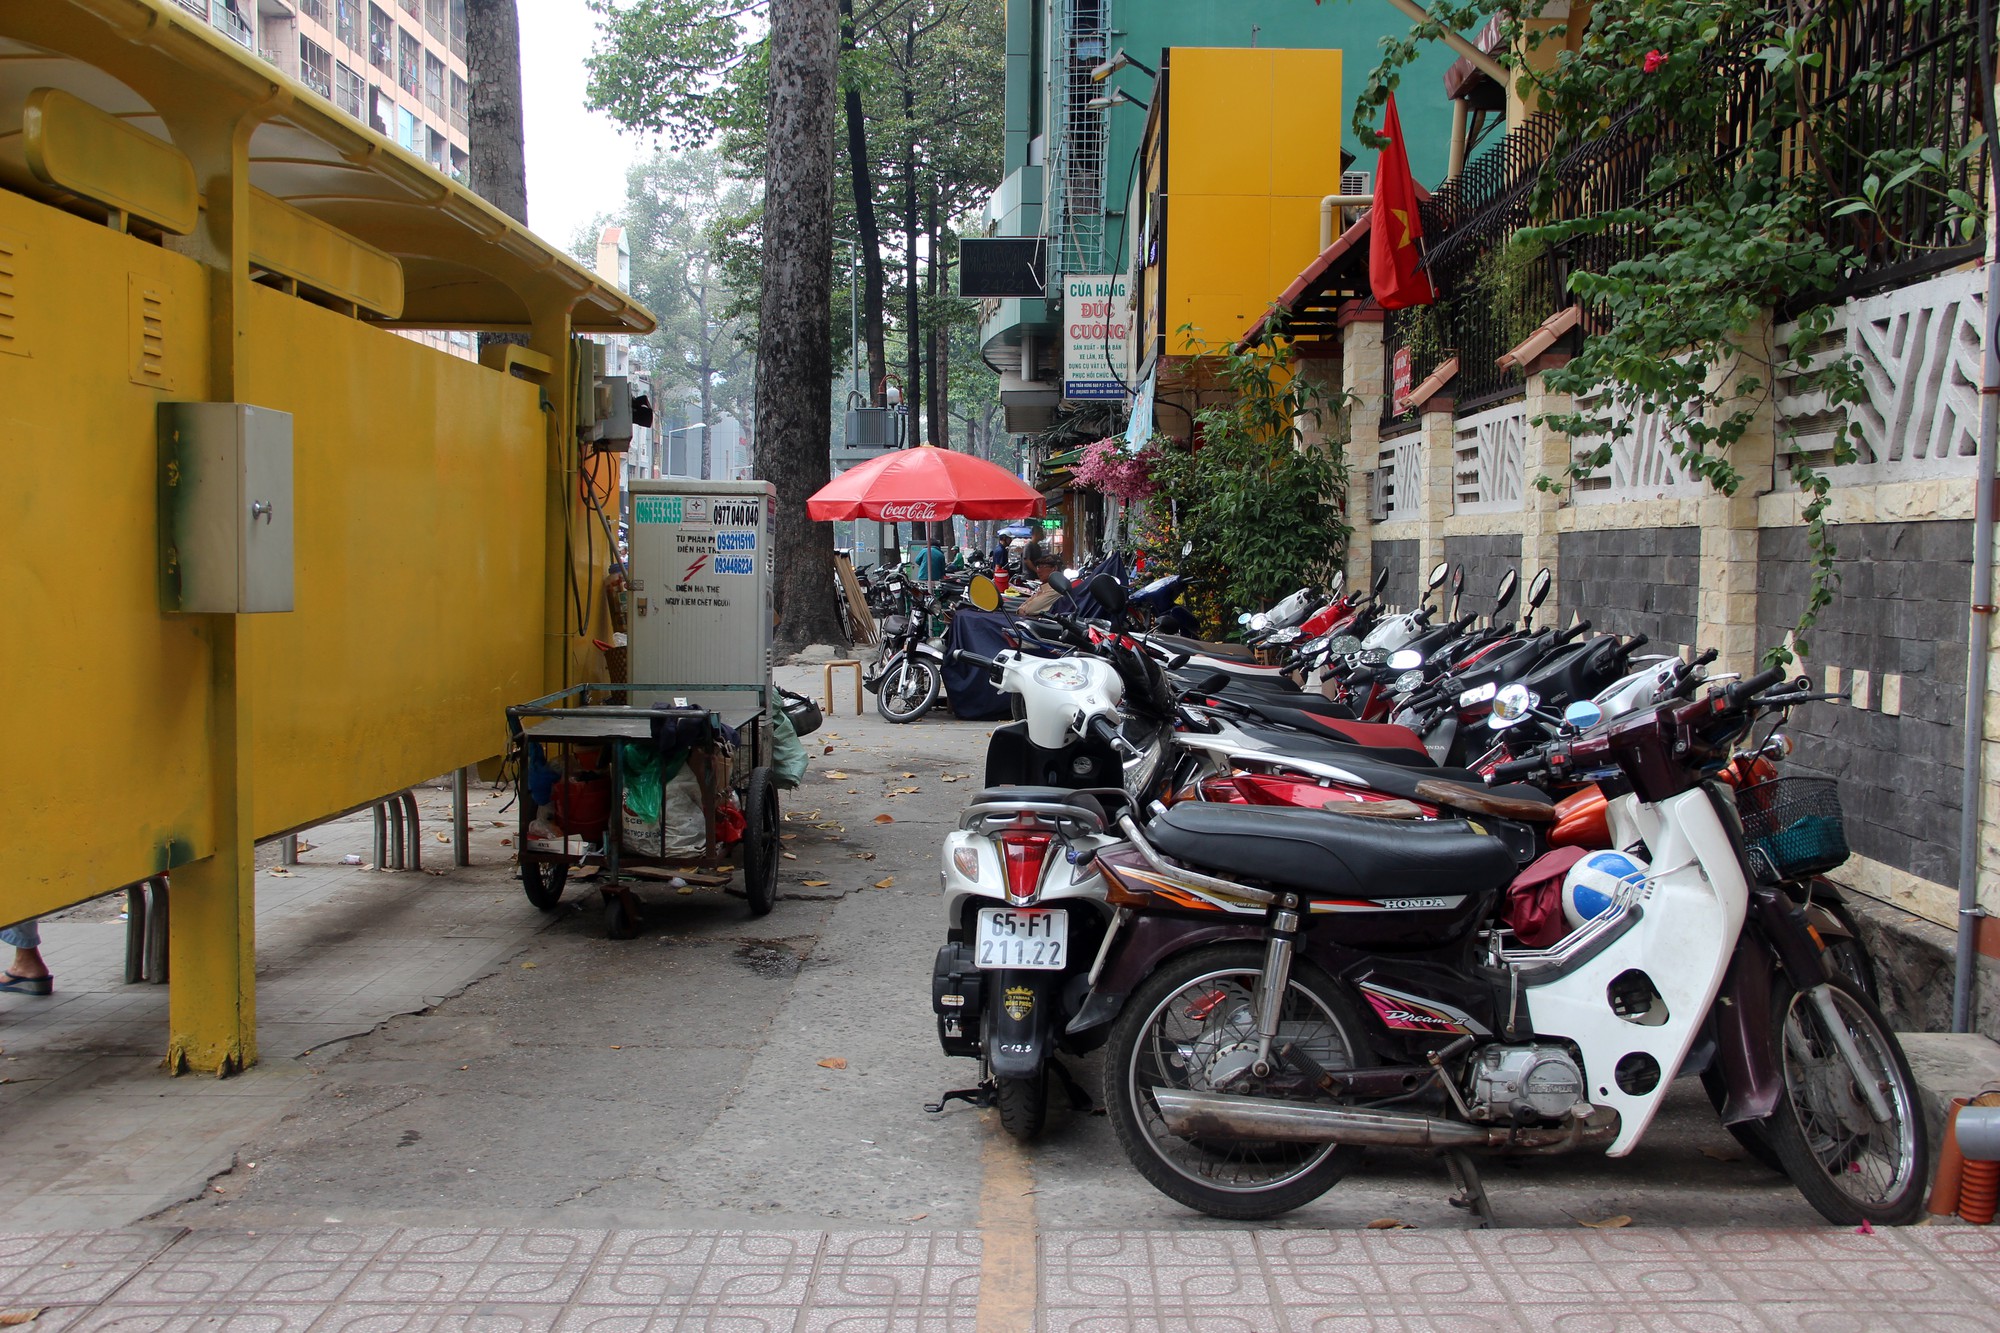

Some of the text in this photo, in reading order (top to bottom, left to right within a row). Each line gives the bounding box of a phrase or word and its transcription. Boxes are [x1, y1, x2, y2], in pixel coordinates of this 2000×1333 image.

[880, 502, 936, 519] Coca-Cola
[717, 534, 755, 550] 0932115110
[1384, 898, 1446, 909] HONDA
[981, 940, 1060, 965] 211.22
[1384, 1010, 1450, 1024] Dream
